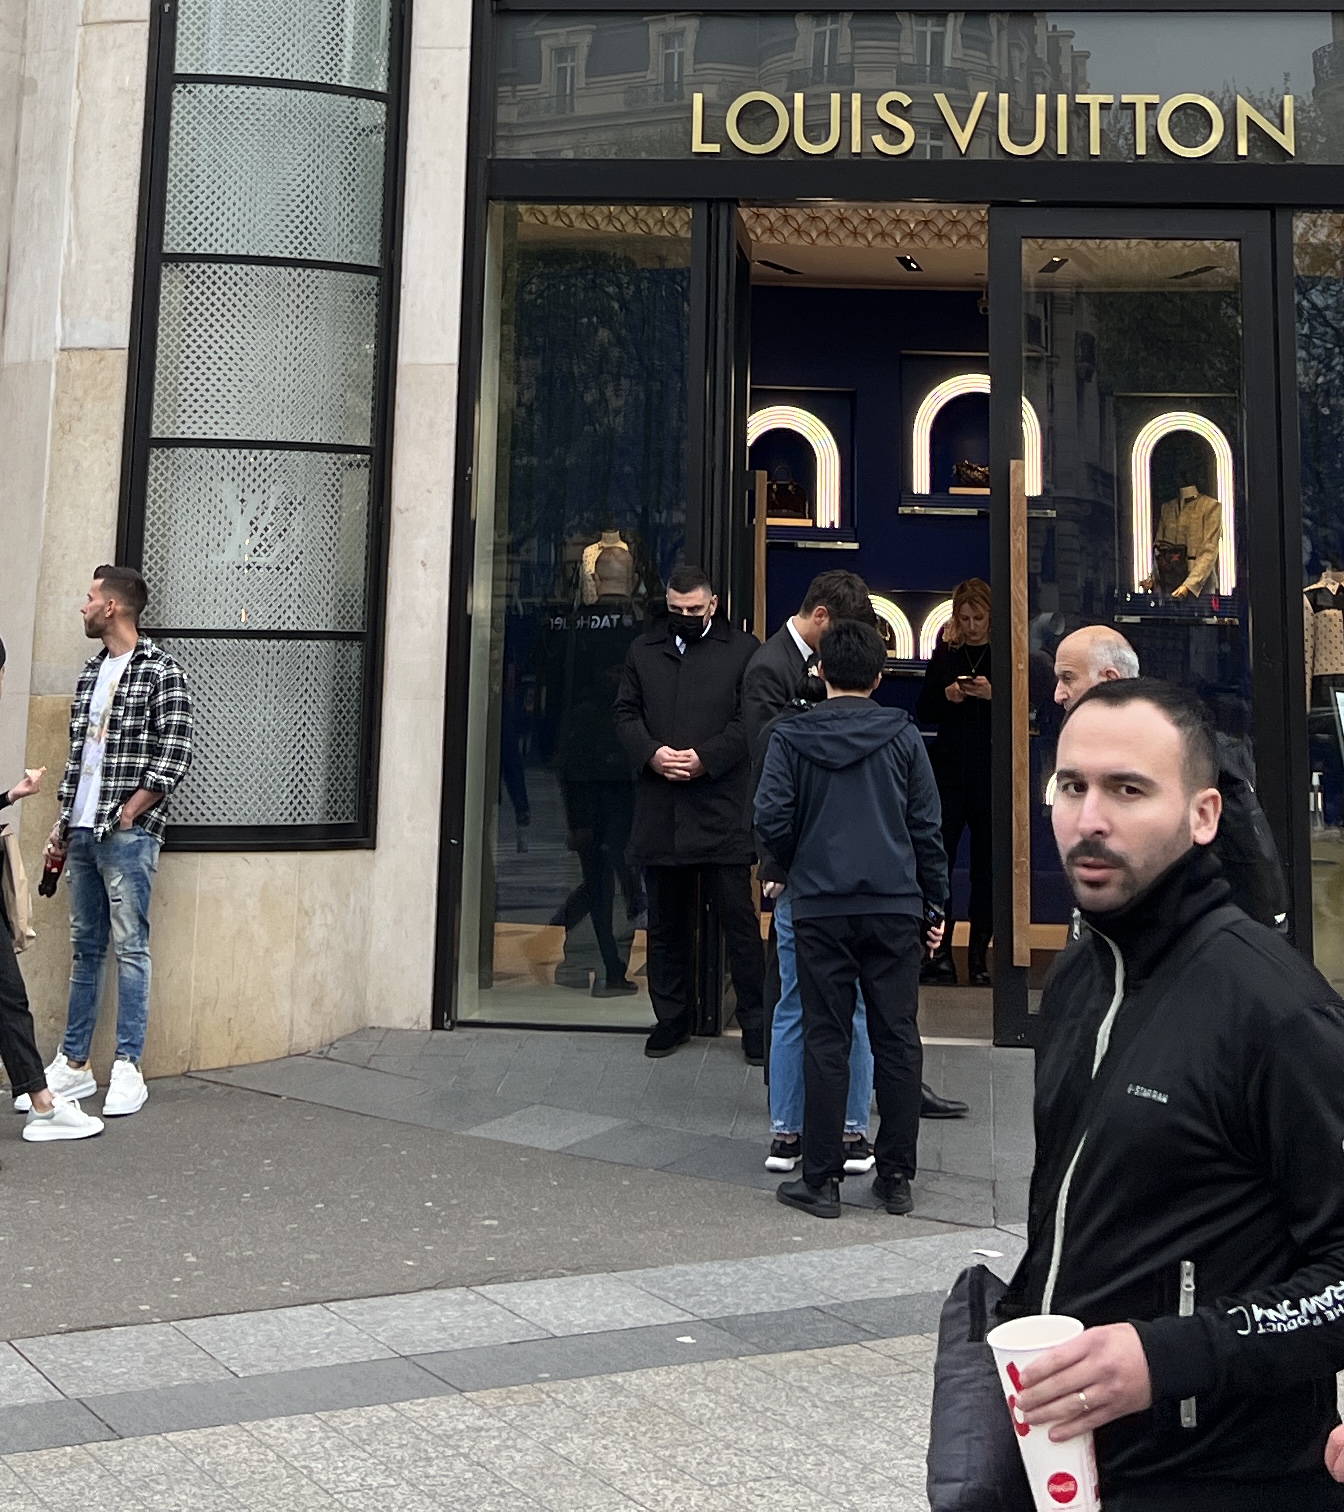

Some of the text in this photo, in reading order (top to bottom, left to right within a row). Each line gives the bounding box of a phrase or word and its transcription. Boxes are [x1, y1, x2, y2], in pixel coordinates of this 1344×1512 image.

[691, 90, 1296, 158] LOUIS VUITTON
[1257, 1315, 1343, 1334] PODUCT
